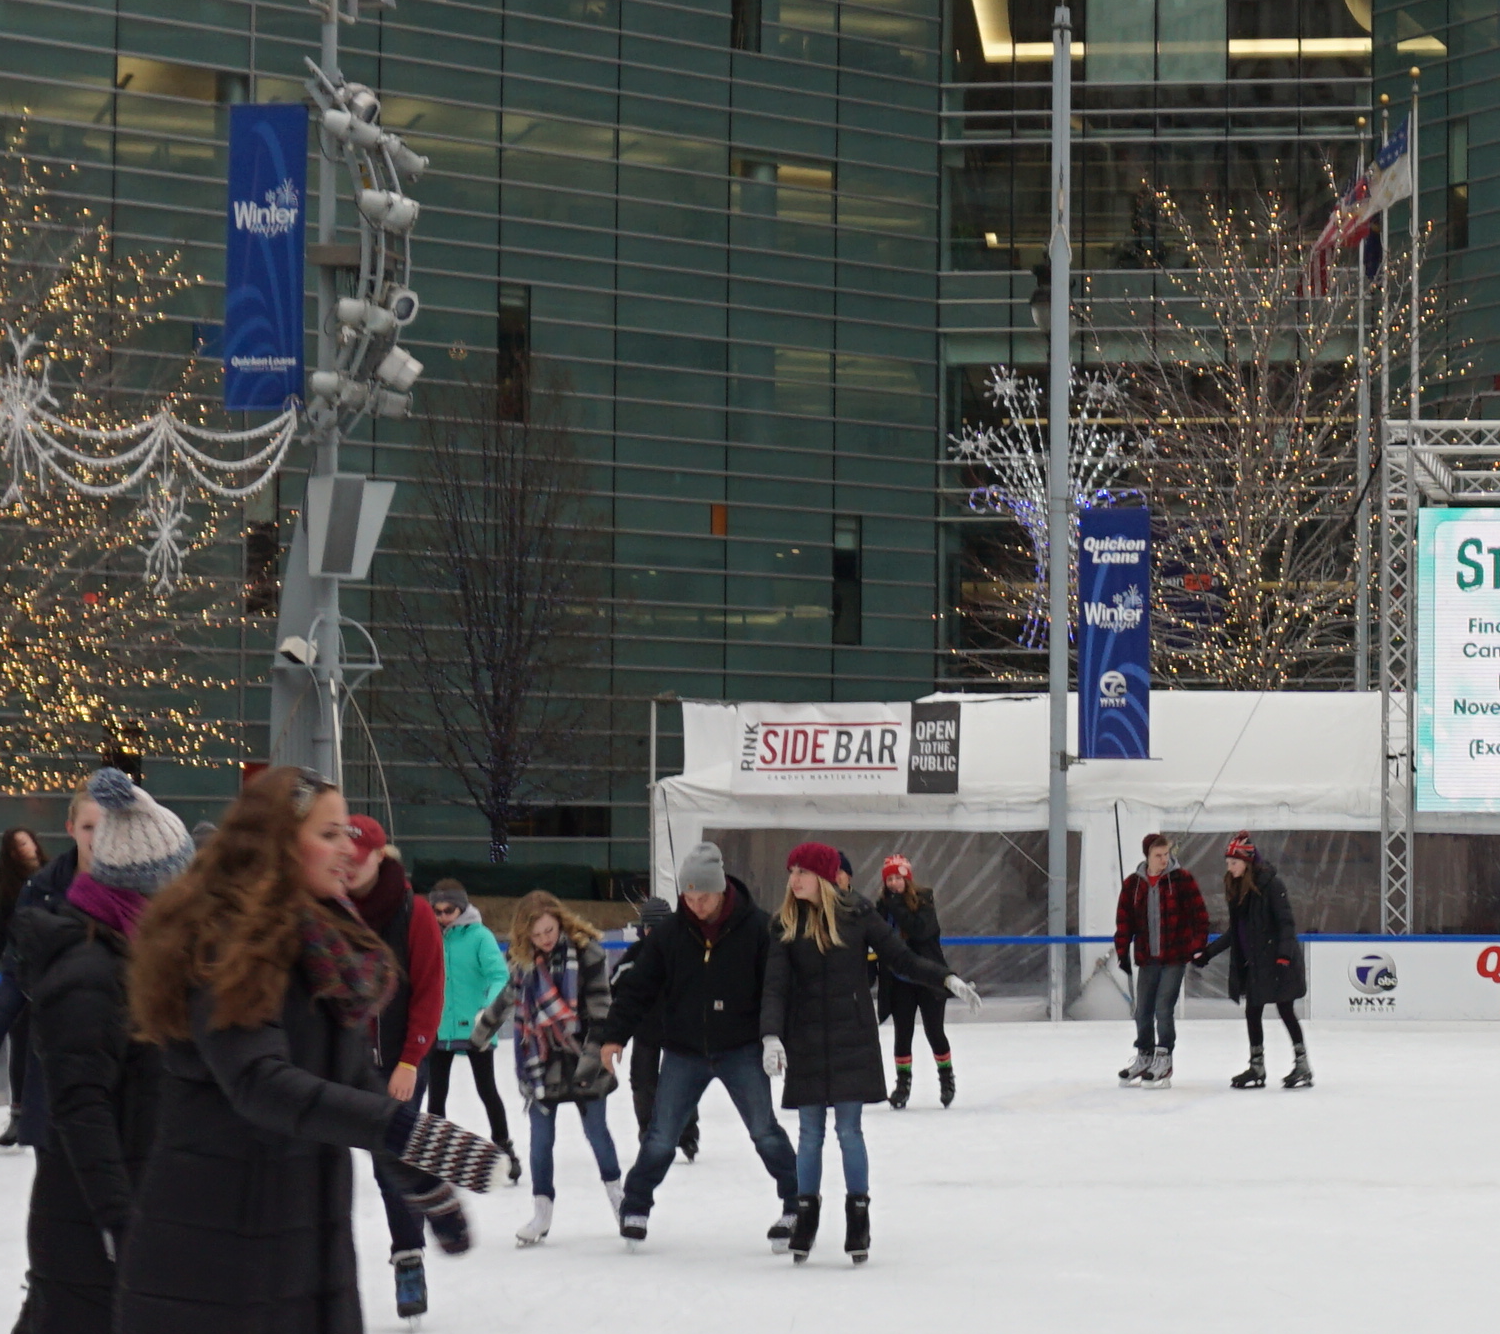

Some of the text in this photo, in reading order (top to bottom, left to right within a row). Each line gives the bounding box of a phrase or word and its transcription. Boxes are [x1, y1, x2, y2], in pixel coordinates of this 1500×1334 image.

[233, 201, 298, 230] Winter
[1083, 536, 1146, 554] Quicken
[1092, 549, 1140, 564] Loans
[1084, 601, 1144, 626] Winter
[915, 720, 957, 740] OPEN
[741, 722, 760, 772] RINK
[920, 741, 951, 754] TO THE
[911, 754, 957, 772] PUBLIC
[1378, 975, 1397, 986] abc
[1349, 997, 1396, 1005] WXYZ
